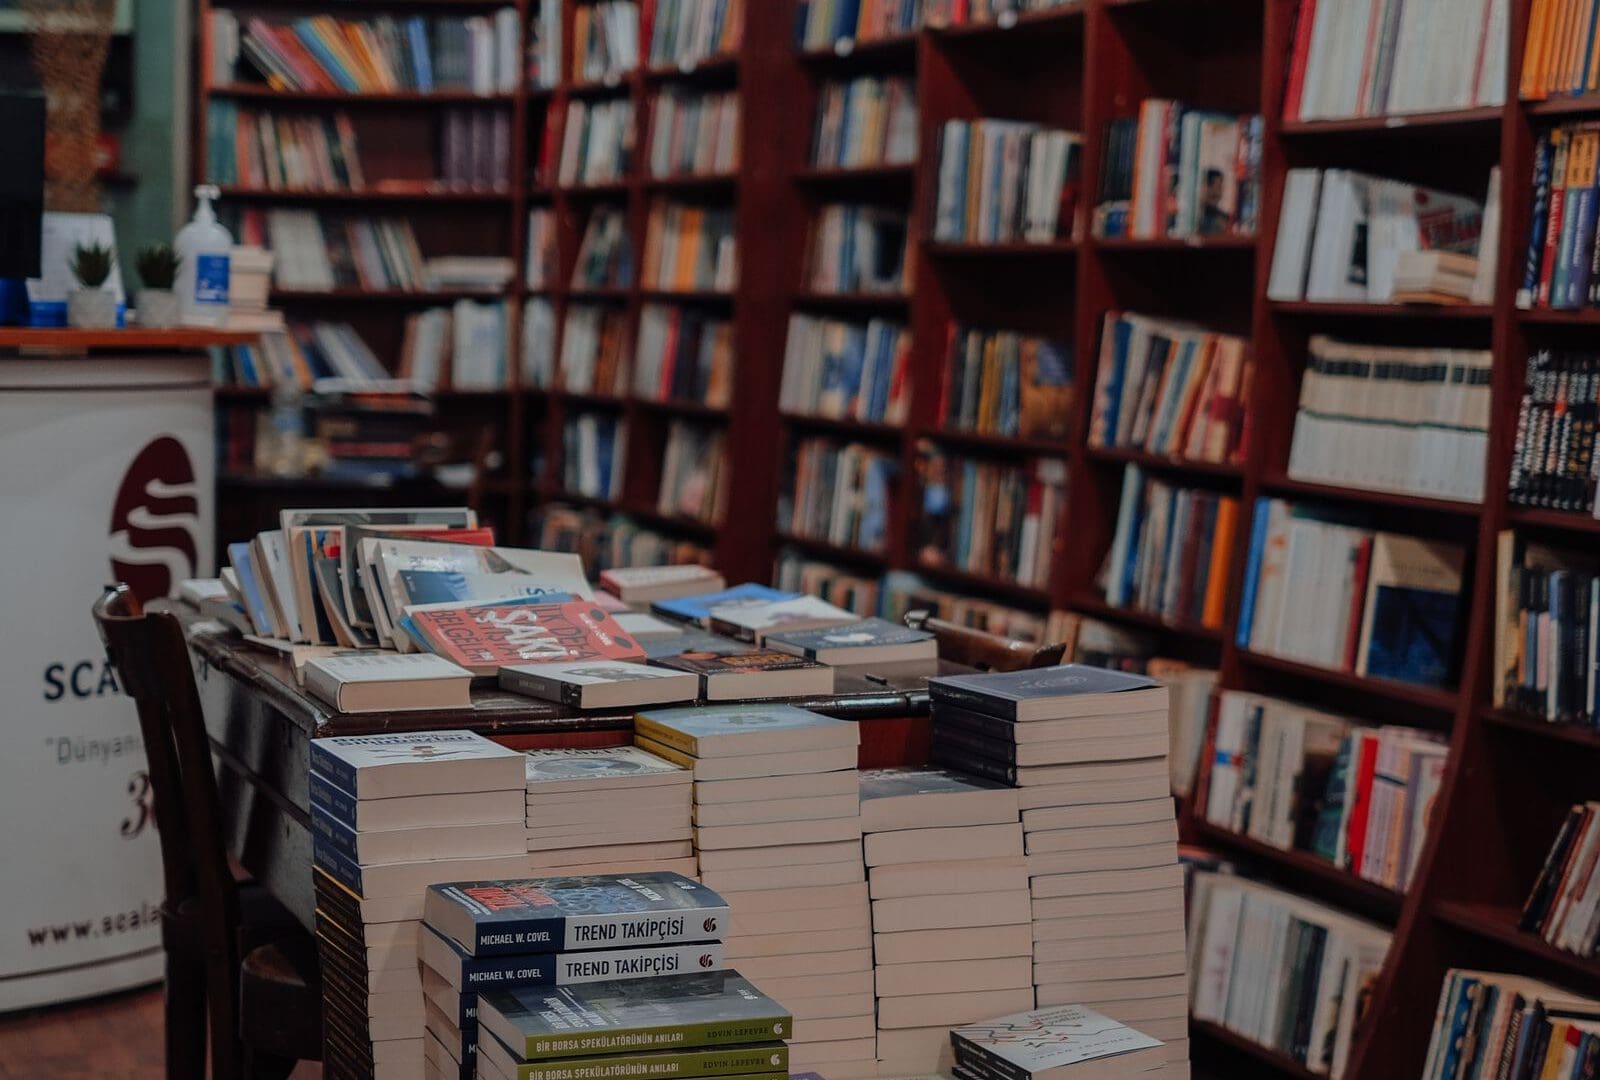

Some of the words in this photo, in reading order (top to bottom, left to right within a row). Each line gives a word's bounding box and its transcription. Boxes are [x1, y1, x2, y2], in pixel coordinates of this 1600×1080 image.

[44, 660, 119, 700] SCA
[121, 770, 158, 839] 3
[28, 902, 161, 946] www.scala
[574, 923, 617, 942] TREND
[621, 916, 684, 941] TAKİPÇİSİ
[480, 933, 513, 945] MICHAEL
[516, 933, 525, 943] W.
[527, 931, 551, 942] COVEL
[469, 970, 504, 982] MICHAEL
[506, 969, 515, 980] W.
[517, 968, 541, 979] COVEL
[566, 960, 609, 978] TREND
[614, 953, 679, 977] TAKİPÇİSİ
[536, 1040, 550, 1052] BİR
[552, 1038, 579, 1051] BORSA
[581, 1033, 653, 1049] SPEKÜLATÖRÜNÜN
[655, 1032, 684, 1043] ANILARI
[735, 1026, 769, 1036] LEFEVRE
[529, 1070, 544, 1080] BİR
[546, 1069, 572, 1080] BORSA
[575, 1063, 648, 1078] SPEKÜLATÖRÜNÜN
[650, 1062, 680, 1073] ANILARI
